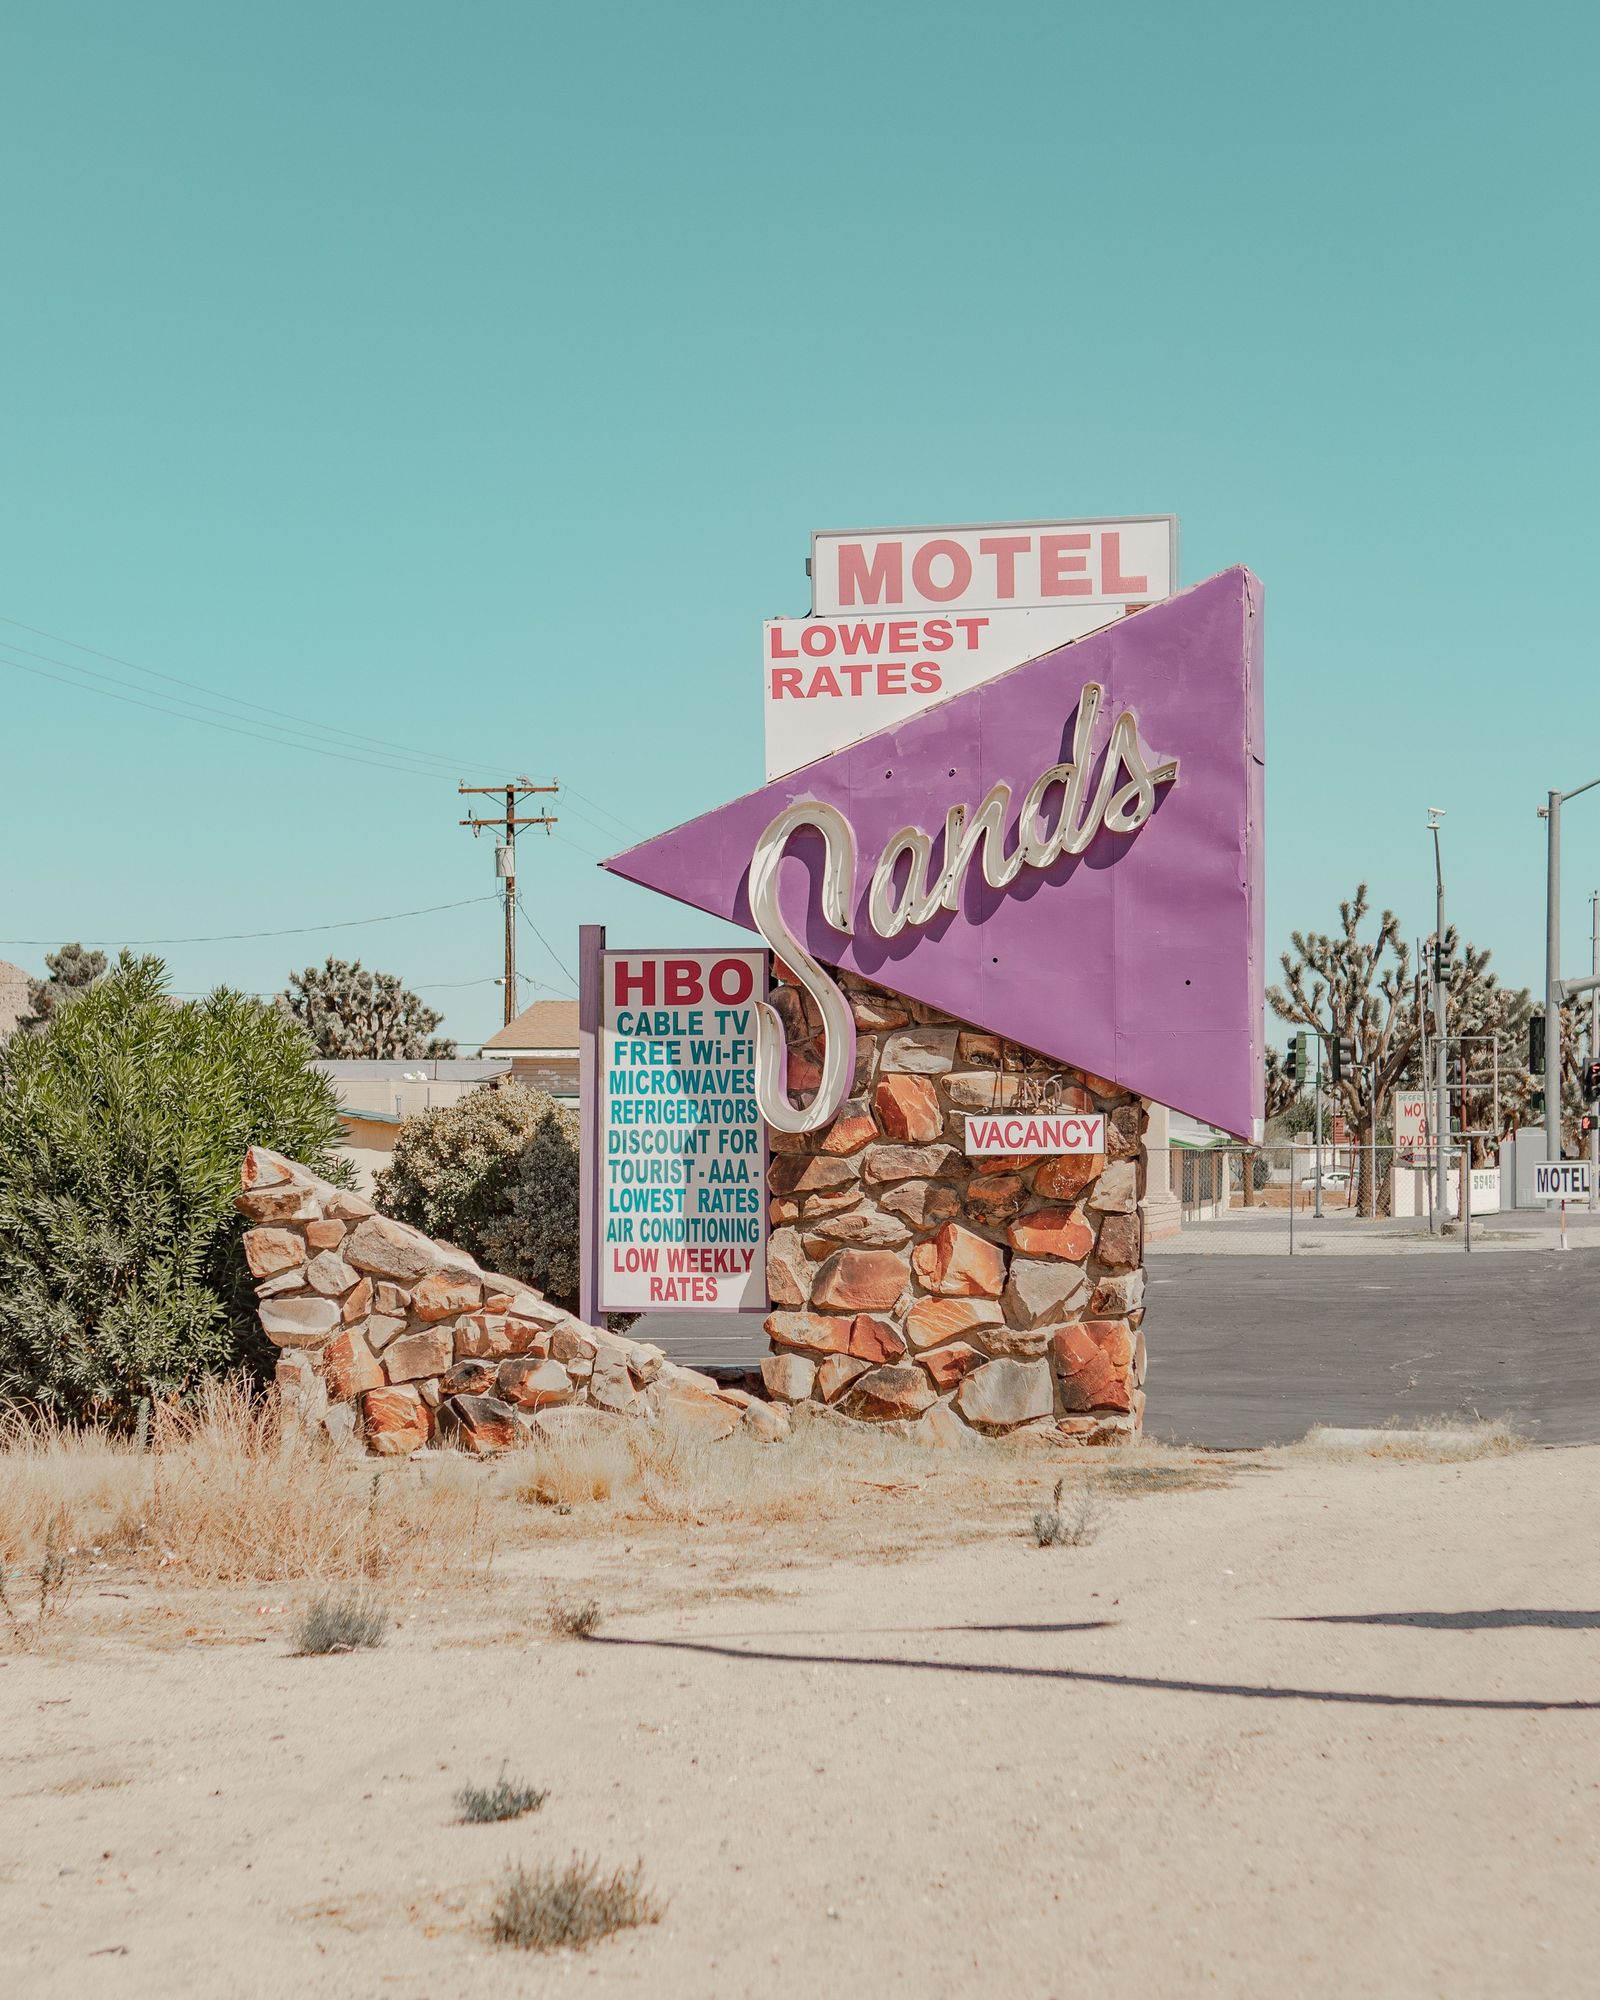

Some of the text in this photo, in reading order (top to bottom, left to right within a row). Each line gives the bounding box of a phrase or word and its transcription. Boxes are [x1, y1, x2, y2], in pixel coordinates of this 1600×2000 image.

[838, 531, 1148, 606] MOTEL
[770, 617, 990, 659] LOWEST
[770, 661, 943, 699] RATES
[748, 681, 1180, 1133] Sands
[614, 958, 754, 1006] HBO
[616, 1010, 750, 1036] CABLE TV
[614, 1040, 754, 1066] FREE Wi-Fi
[609, 1069, 756, 1095] MICROWAVES
[611, 1099, 758, 1125] REFRIGERATORS
[608, 1129, 758, 1154] DISCOUNT FOR
[968, 1119, 1101, 1149] VACANCY
[1537, 1167, 1590, 1193] MOTEL
[609, 1188, 760, 1214] LOWEST RATES
[606, 1218, 760, 1243] AIR CONDITIONING
[613, 1248, 755, 1273] LOW WEEKLY
[650, 1277, 718, 1302] RATES
